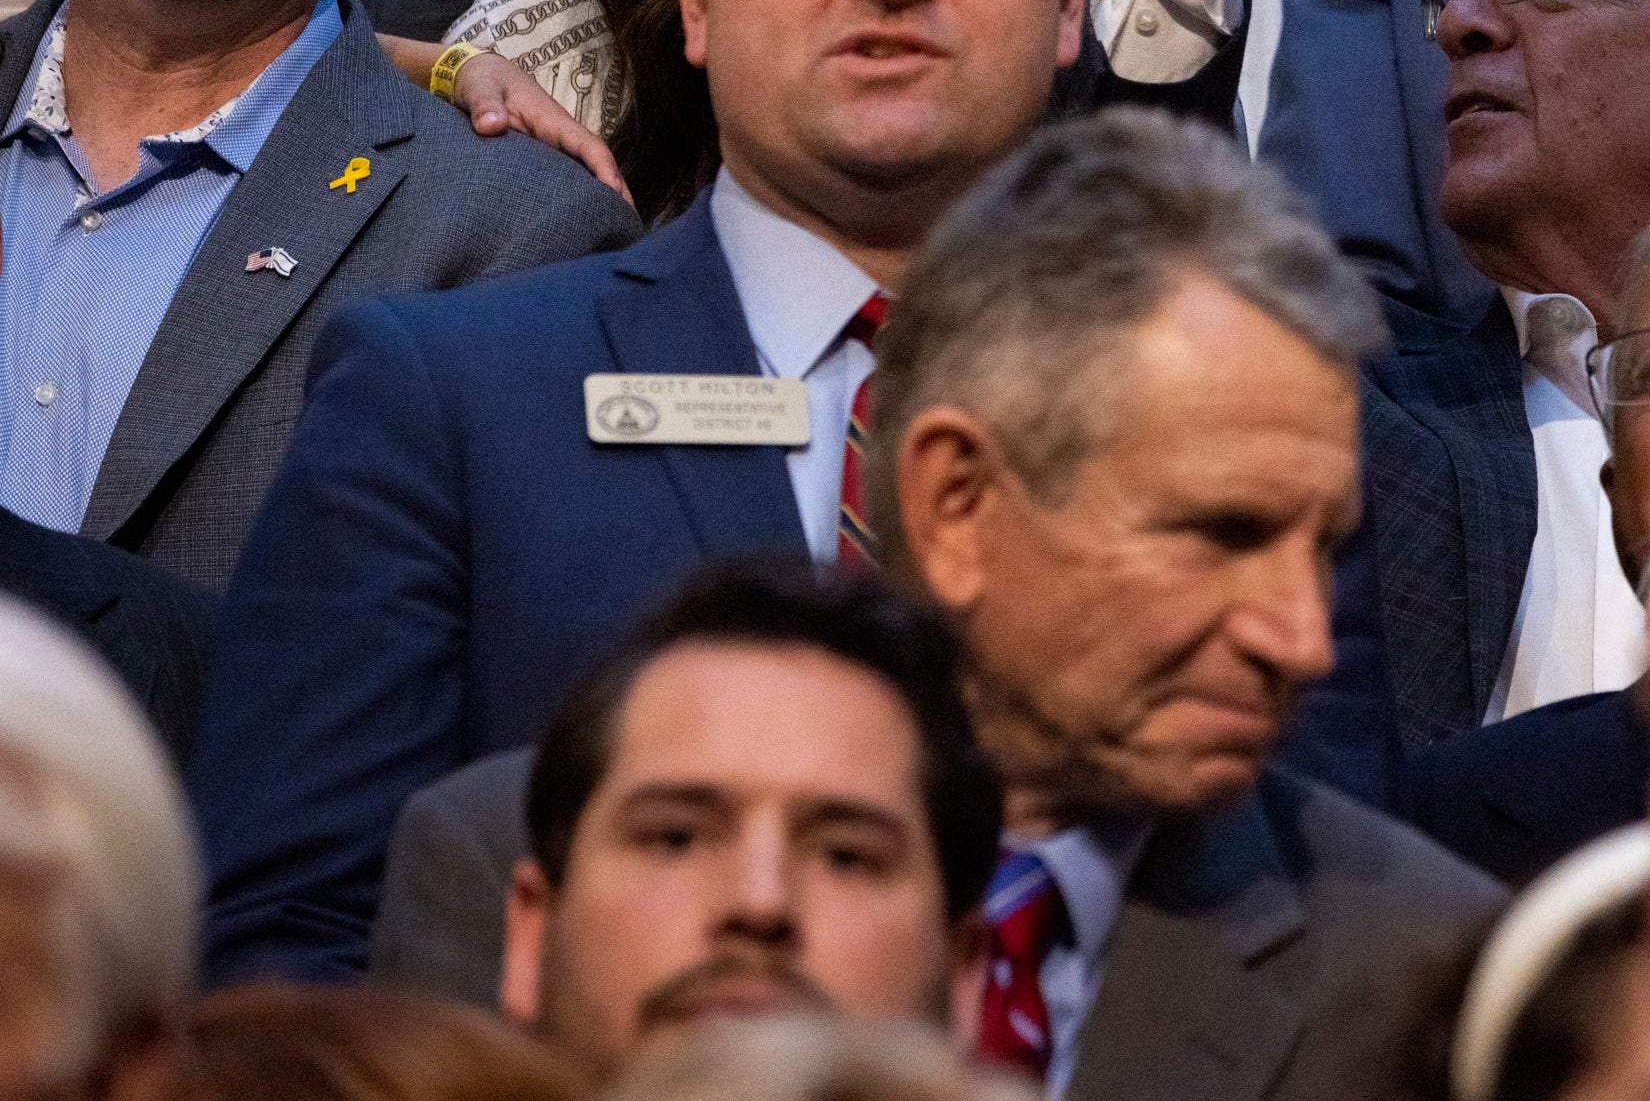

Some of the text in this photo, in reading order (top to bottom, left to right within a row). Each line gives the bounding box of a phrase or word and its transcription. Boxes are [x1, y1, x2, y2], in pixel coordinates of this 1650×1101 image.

[619, 380, 776, 396] SCOTT HILTON
[674, 402, 785, 414] REPRESENTATIVE
